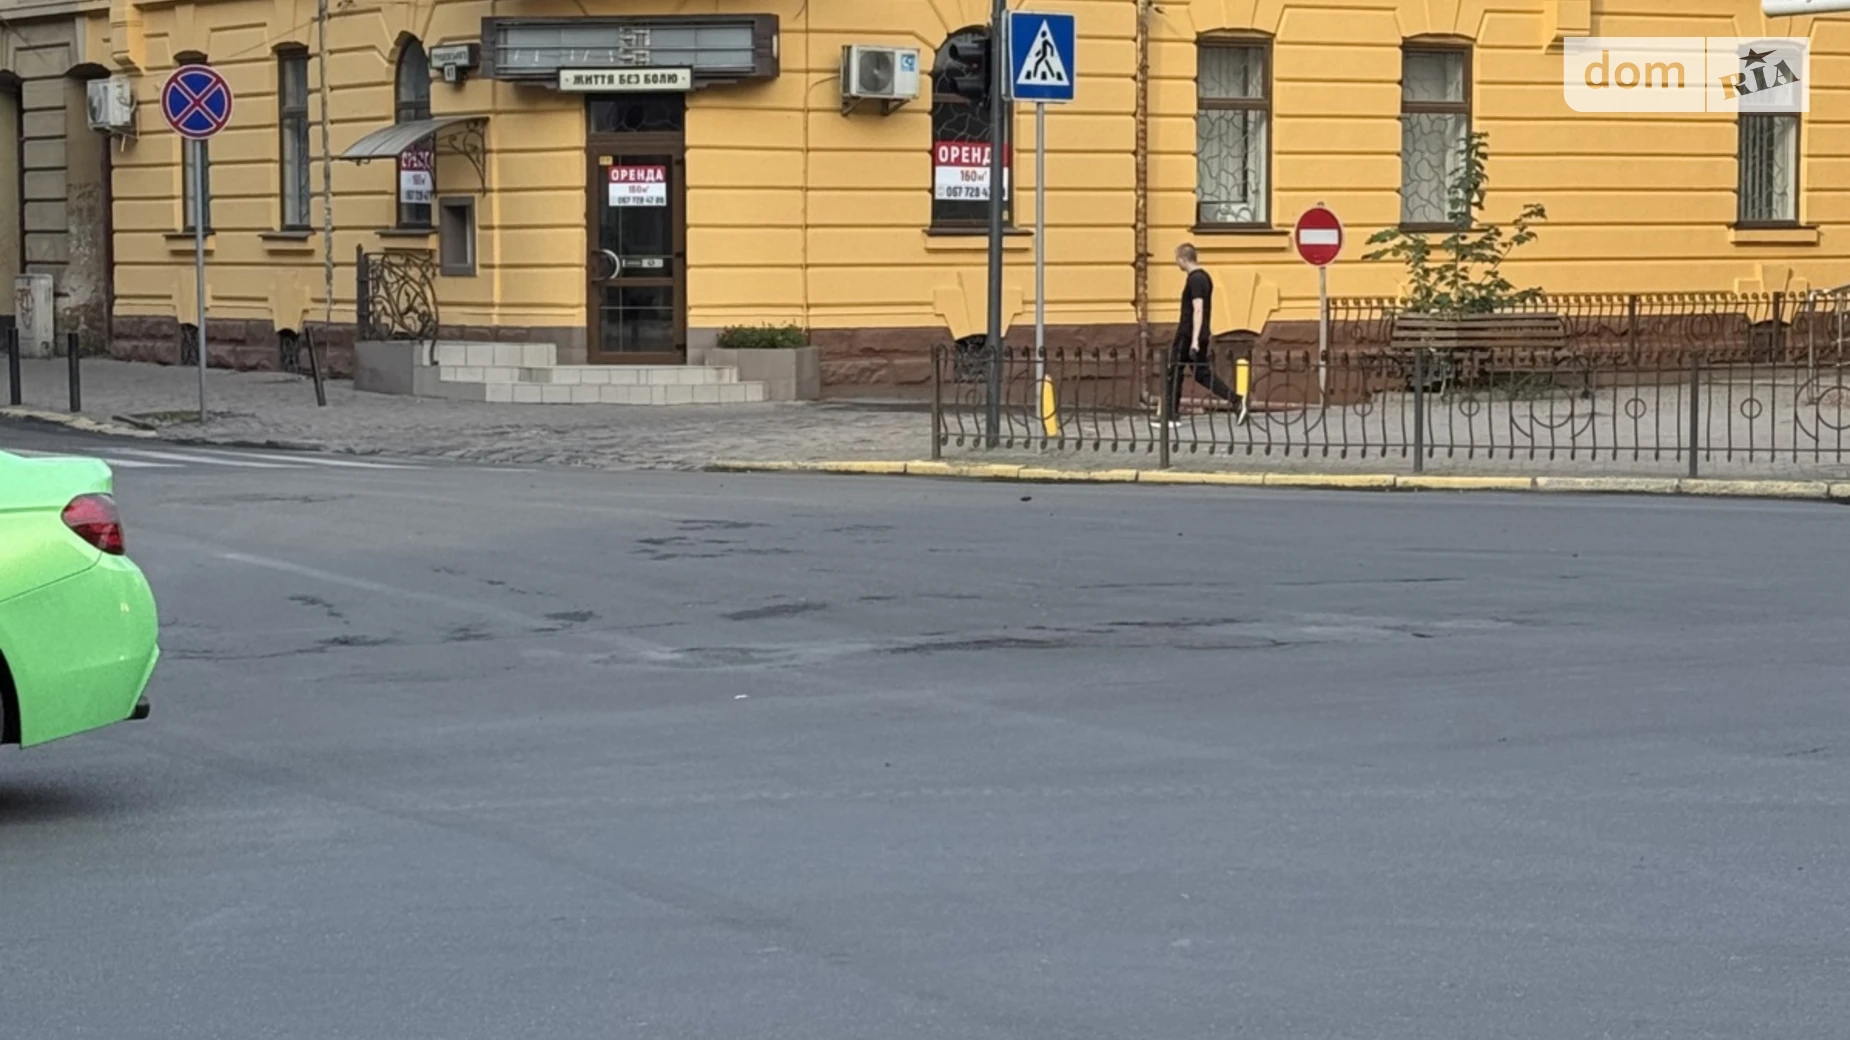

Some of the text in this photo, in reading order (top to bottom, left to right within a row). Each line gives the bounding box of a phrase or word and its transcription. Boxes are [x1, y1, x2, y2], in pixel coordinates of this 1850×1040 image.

[573, 73, 678, 85] ЖИТТЯ БЕЗ БОЛЮ
[611, 168, 664, 182] ОРЕНДА
